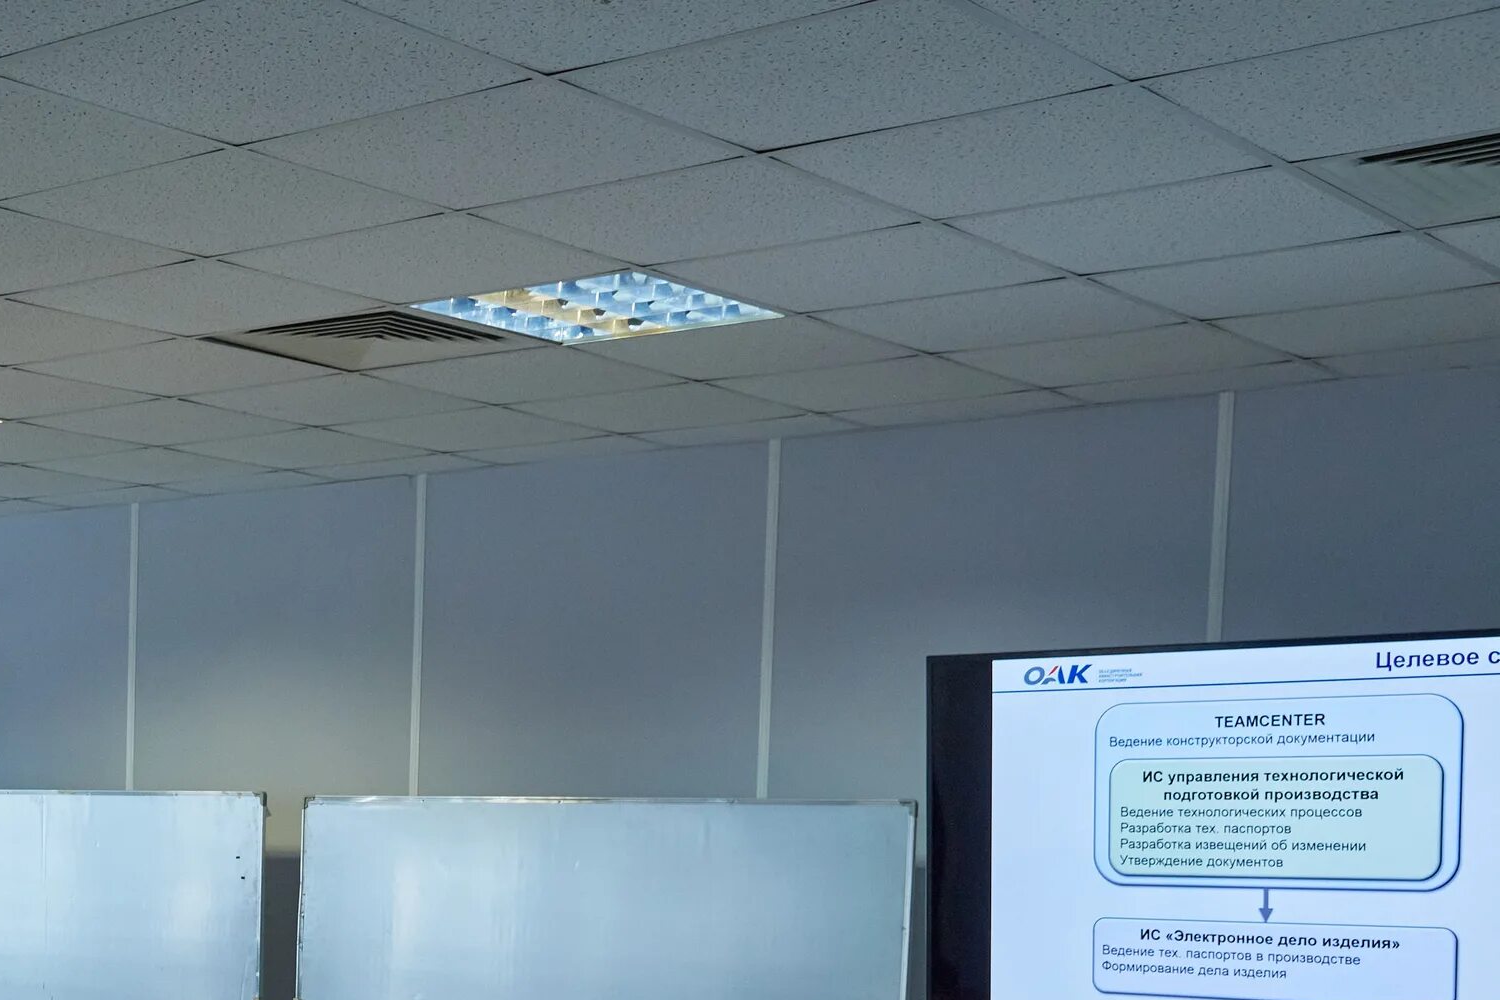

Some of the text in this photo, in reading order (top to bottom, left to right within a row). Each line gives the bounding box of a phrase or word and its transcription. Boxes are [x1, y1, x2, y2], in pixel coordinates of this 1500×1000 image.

[1376, 651, 1480, 672] Целевое
[1214, 713, 1326, 728] TEAMCENTER
[1109, 732, 1376, 748] Ведение конструкторской документации
[1142, 768, 1404, 785] ИС управления технологической
[1163, 788, 1379, 803] подготовкой производства
[1120, 806, 1363, 820] Ведение технологических процессов
[1120, 822, 1292, 836] Разработка тех. паспортов
[1120, 838, 1367, 852] Разработка извещений об изменении
[1119, 854, 1284, 870] Утверждение документов
[1140, 928, 1401, 950] ИС «Электронное дело изделия»
[1102, 944, 1361, 966] Ведение тех. паспортов в производстве
[1101, 959, 1287, 980] Формирование дела изделия
